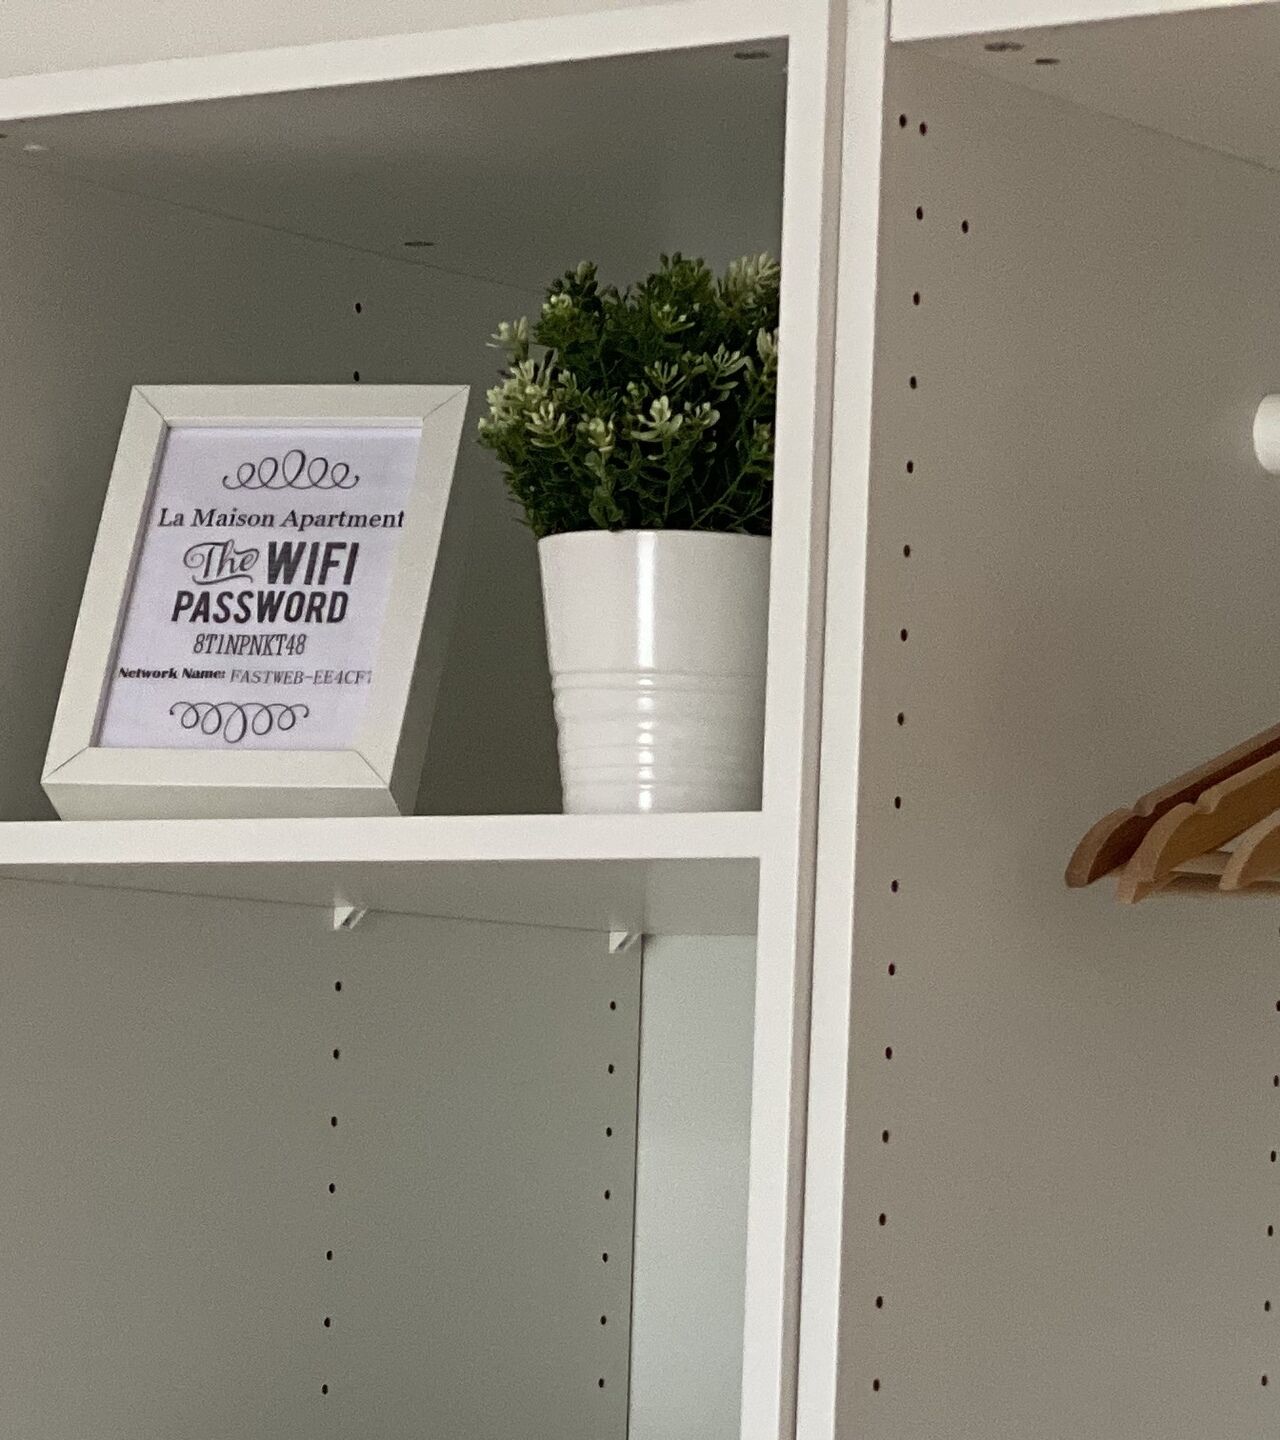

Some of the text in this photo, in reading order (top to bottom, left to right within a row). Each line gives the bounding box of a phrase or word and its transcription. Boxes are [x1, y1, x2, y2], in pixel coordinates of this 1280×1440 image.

[157, 508, 405, 531] La Maison Apartment
[182, 539, 360, 586] The WIFI
[171, 590, 349, 624] PASSWORD
[118, 667, 178, 680] Network
[182, 667, 225, 680] Name:
